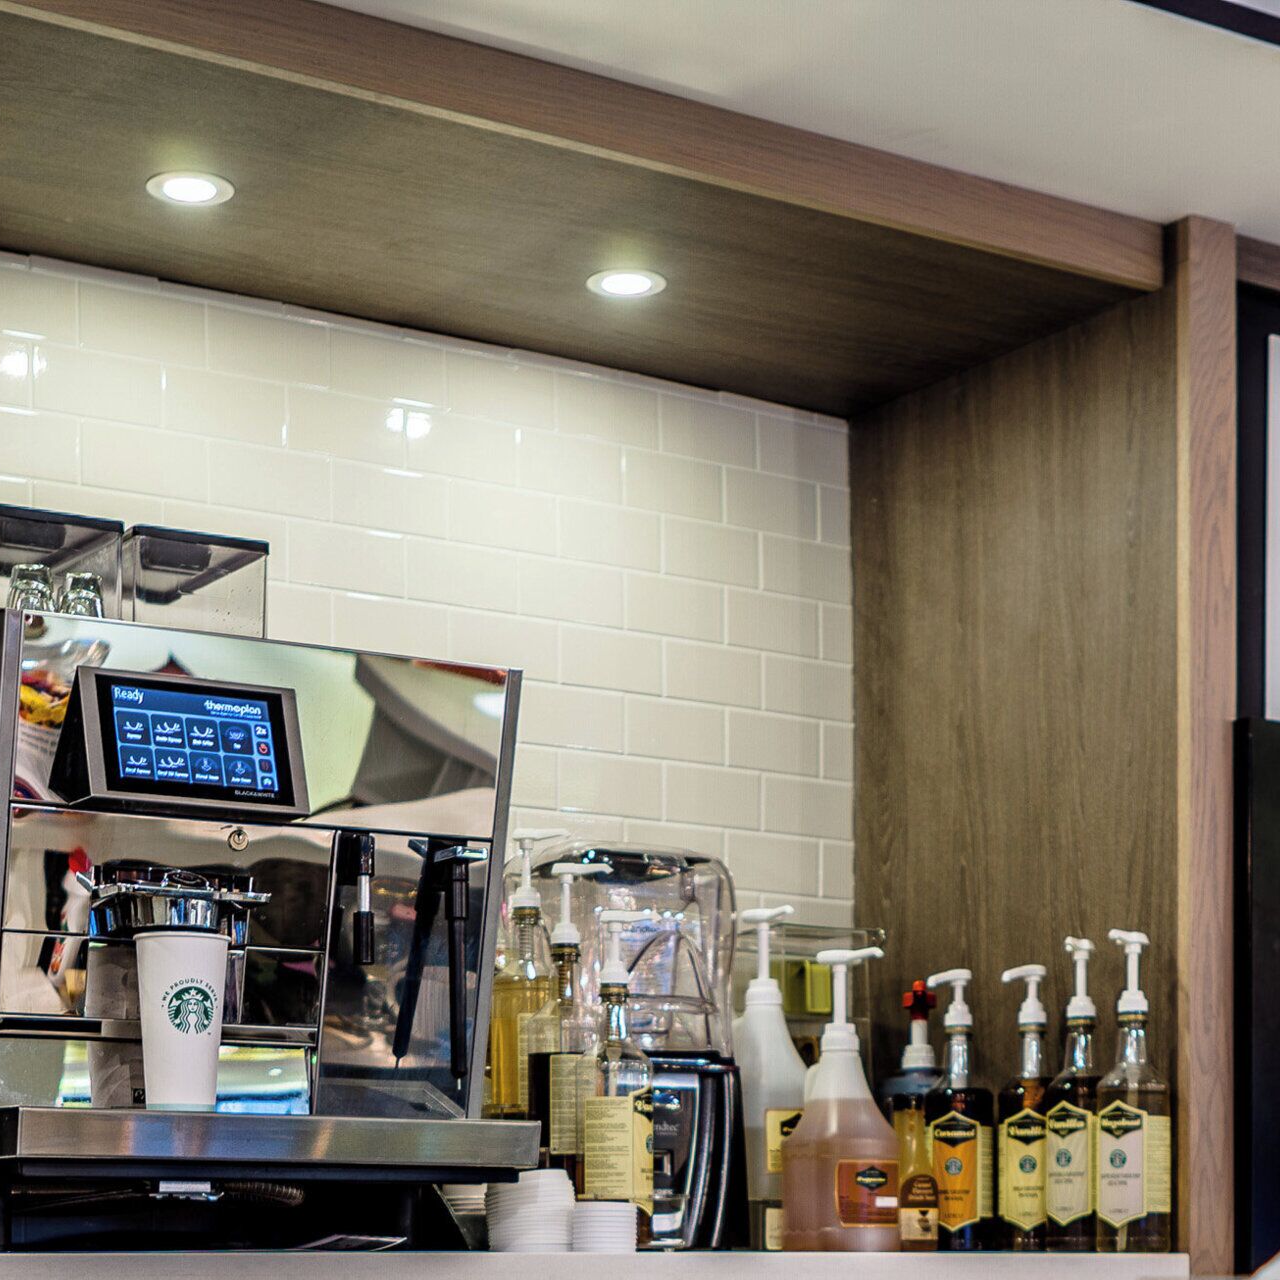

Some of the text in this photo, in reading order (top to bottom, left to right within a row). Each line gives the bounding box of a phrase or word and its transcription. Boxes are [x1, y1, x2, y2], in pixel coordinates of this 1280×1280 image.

[114, 688, 144, 704] Ready
[204, 699, 261, 715] thermoplan
[170, 977, 203, 990] PROUDLY
